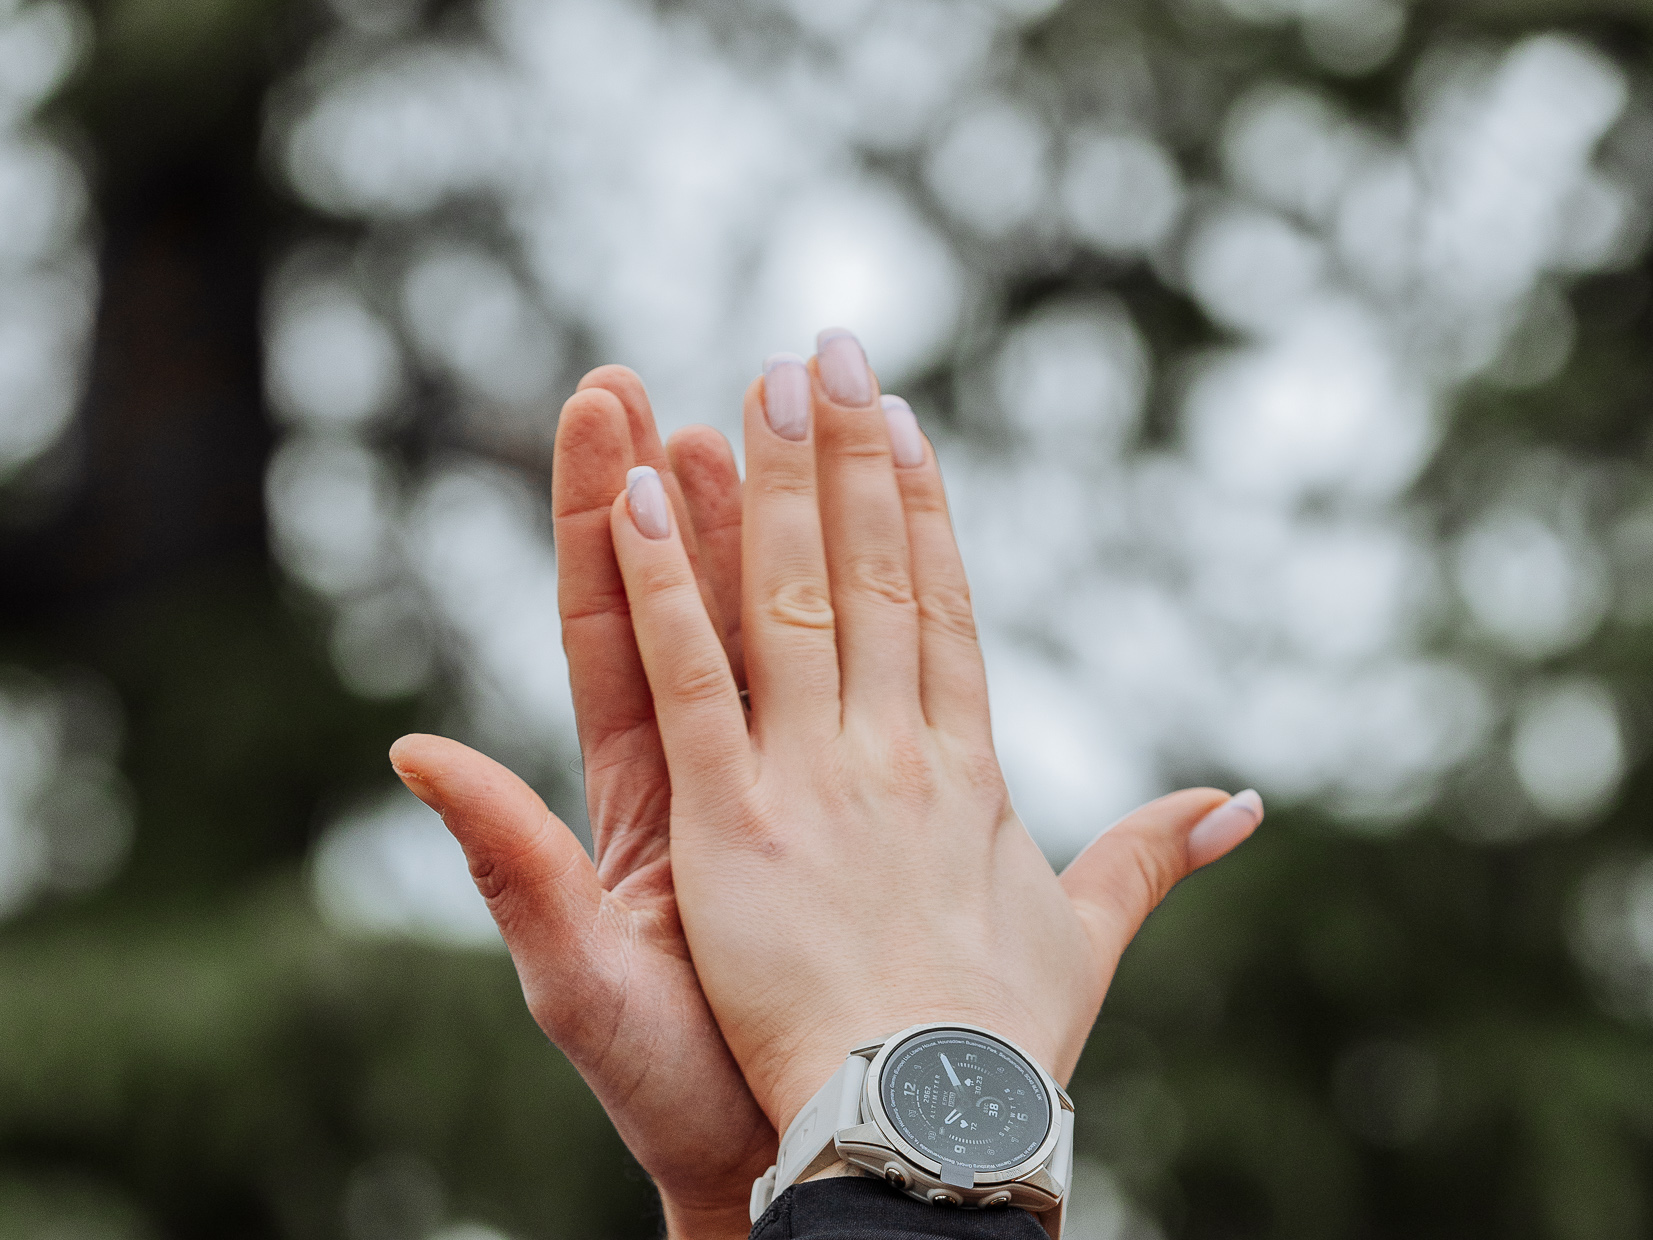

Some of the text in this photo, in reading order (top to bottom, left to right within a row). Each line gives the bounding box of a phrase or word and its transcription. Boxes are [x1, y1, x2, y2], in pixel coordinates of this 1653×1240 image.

[966, 1053, 977, 1062] 3
[904, 1082, 916, 1096] 12
[975, 1075, 983, 1095] 30.23
[923, 1086, 932, 1103] 2962
[930, 1074, 940, 1119] ALTIMETER
[988, 1103, 999, 1117] 38
[1016, 1112, 1028, 1121] 6
[971, 1122, 978, 1130] 72
[955, 1145, 966, 1153] 9
